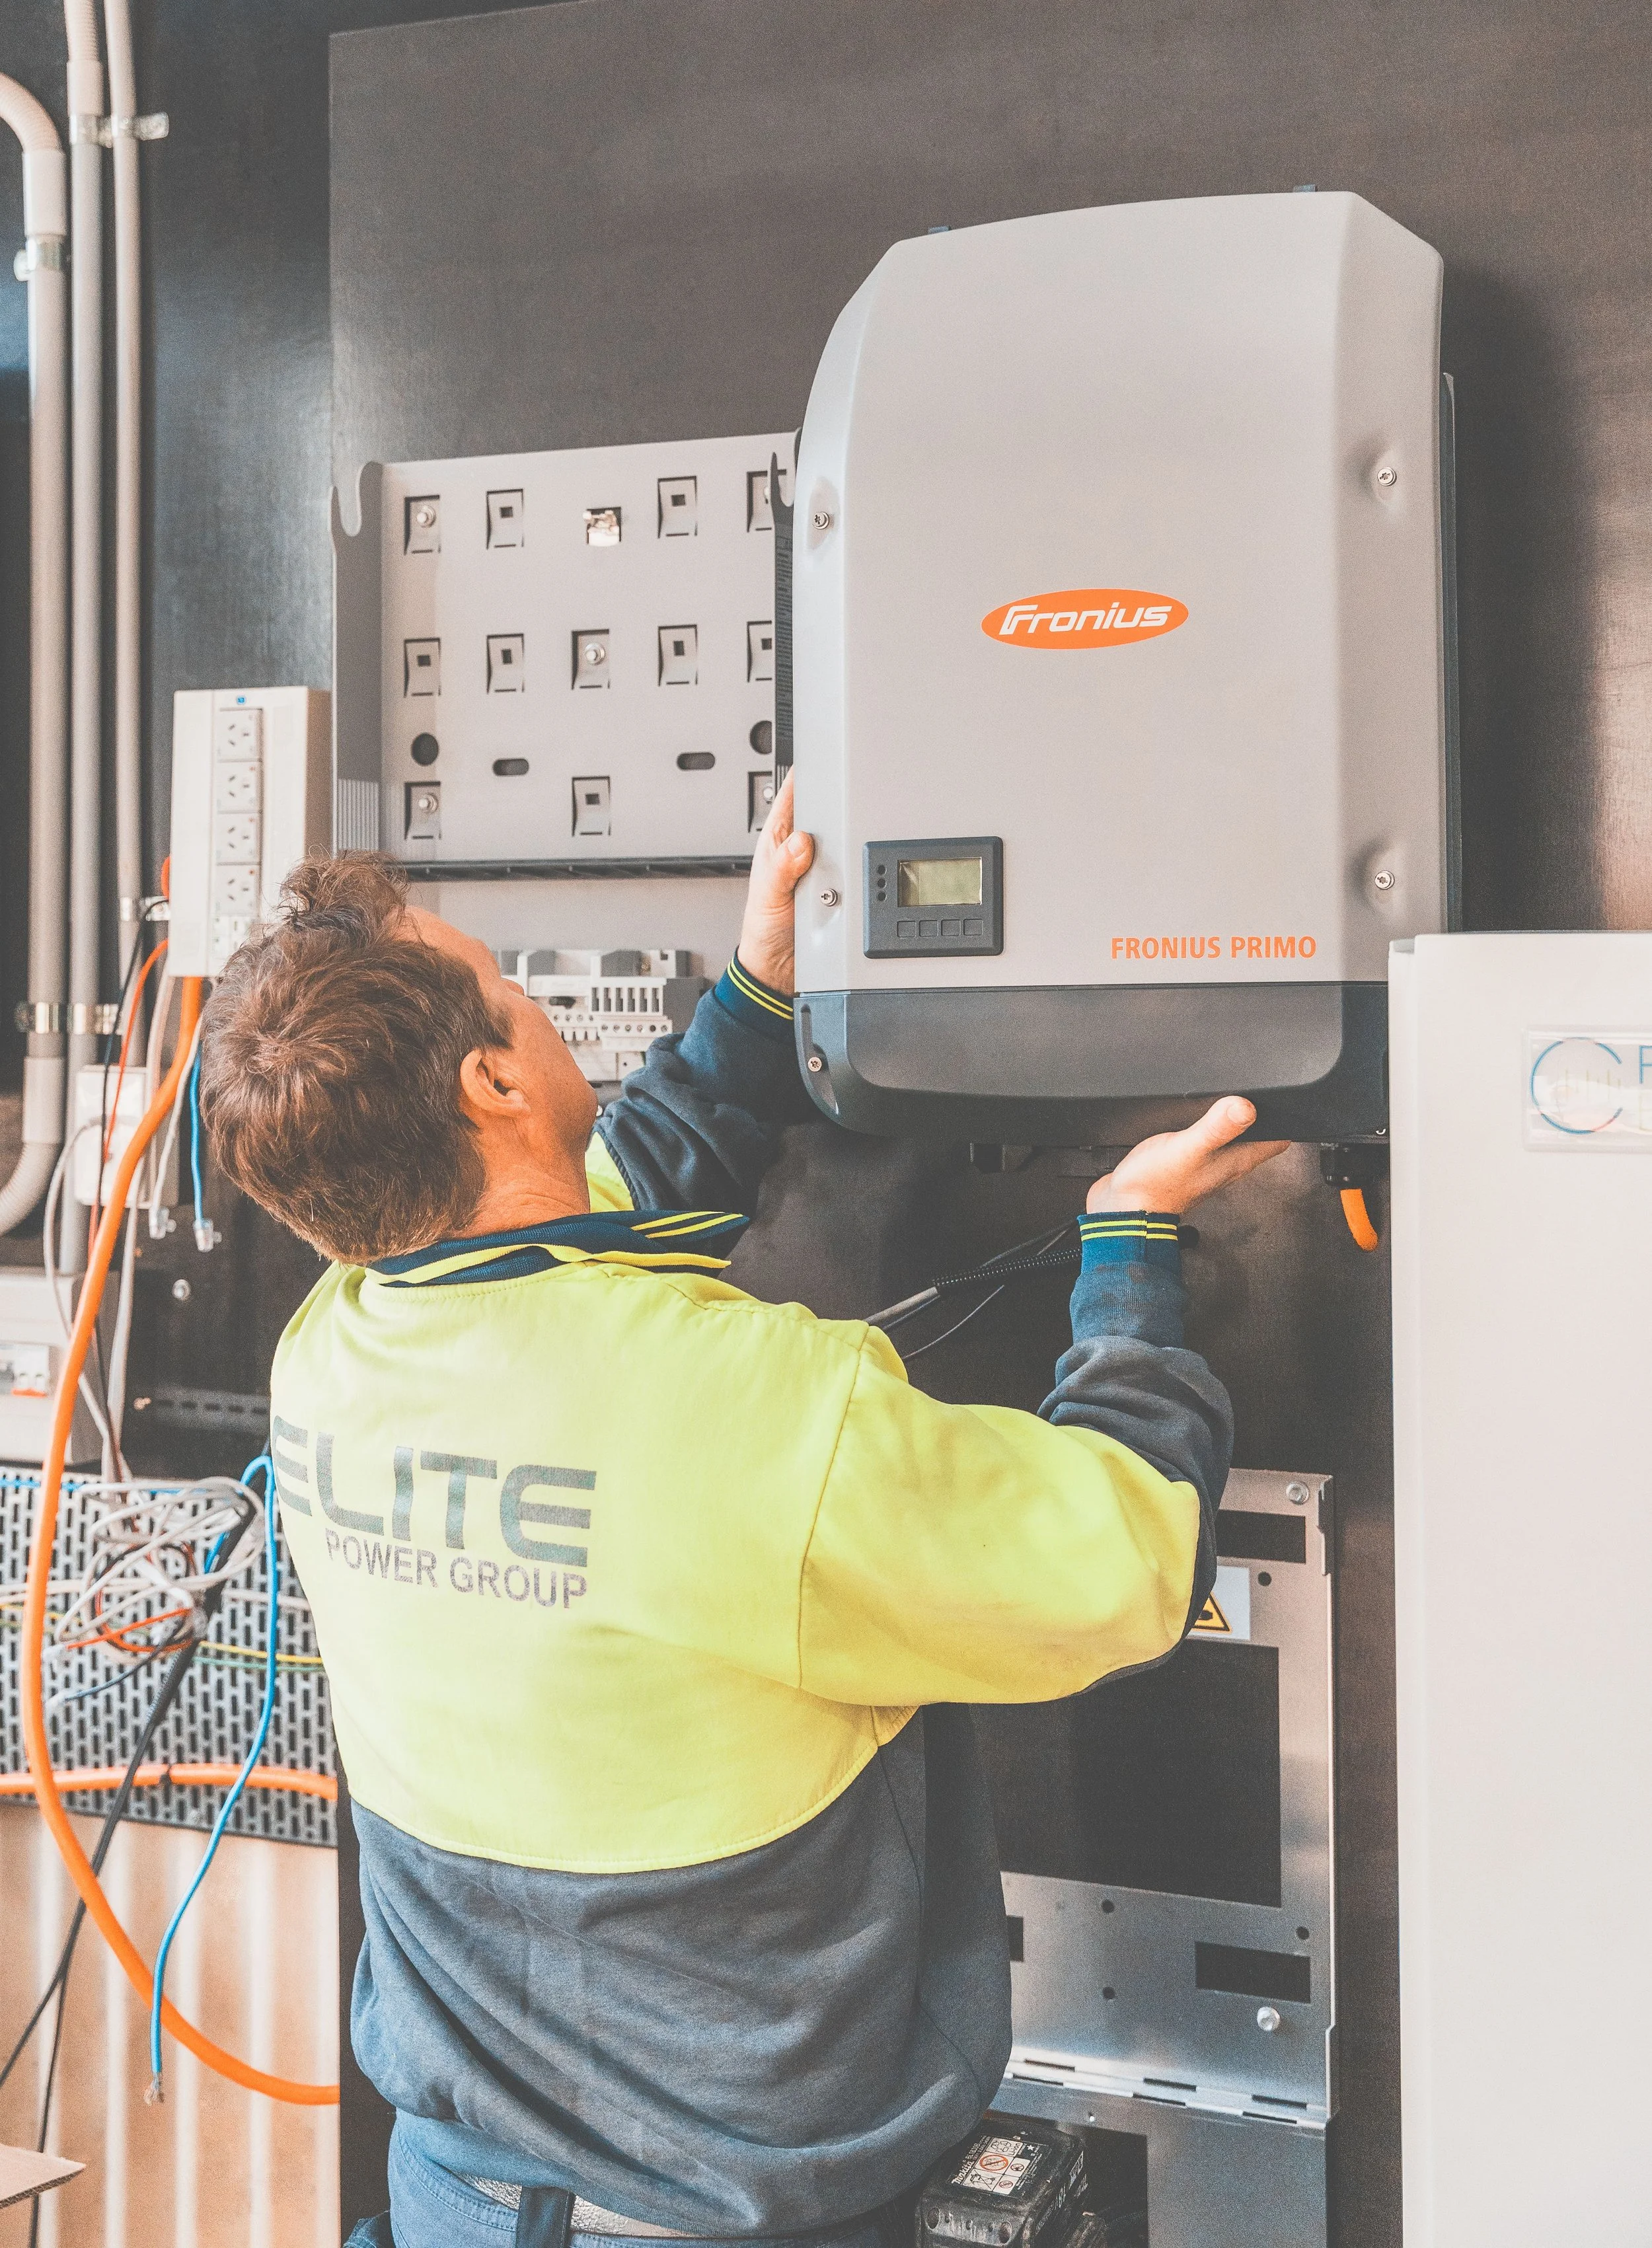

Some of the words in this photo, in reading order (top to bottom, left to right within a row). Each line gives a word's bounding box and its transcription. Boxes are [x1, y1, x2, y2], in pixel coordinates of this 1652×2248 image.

[998, 601, 1172, 635] Fronius
[1111, 936, 1221, 959] FRONIUS
[1230, 936, 1316, 958] PRIMO
[273, 1415, 597, 1567] ELITE
[325, 1528, 439, 1588] POWER
[450, 1556, 587, 1608] GROUP
